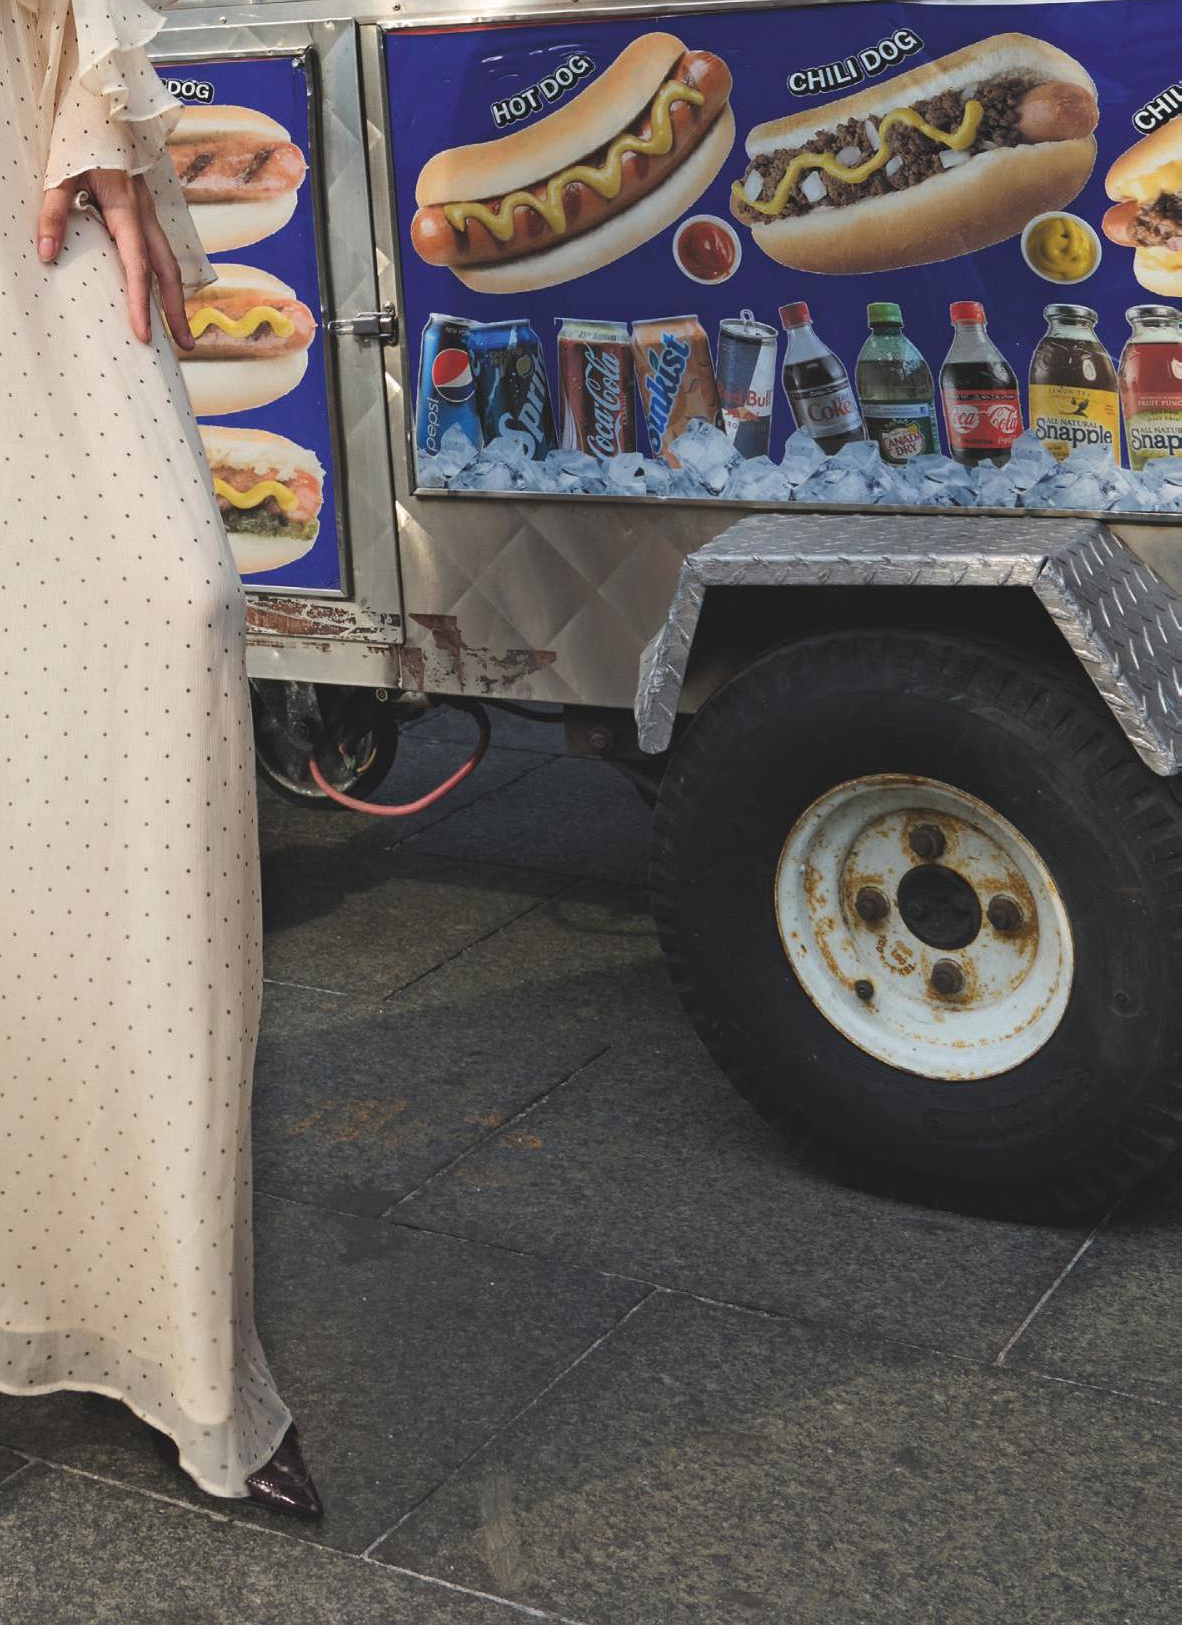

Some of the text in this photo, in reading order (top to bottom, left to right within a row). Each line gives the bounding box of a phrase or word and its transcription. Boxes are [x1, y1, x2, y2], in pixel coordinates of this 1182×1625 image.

[789, 31, 918, 92] CHILI DOG
[168, 80, 210, 99] DOG
[493, 55, 589, 124] HOT DOG
[808, 397, 852, 423] Coke
[1060, 418, 1098, 428] NATURAL
[426, 397, 439, 452] pepsi
[1036, 418, 1112, 448] Snapple
[882, 432, 922, 452] CANADA
[896, 442, 918, 457] DRY
